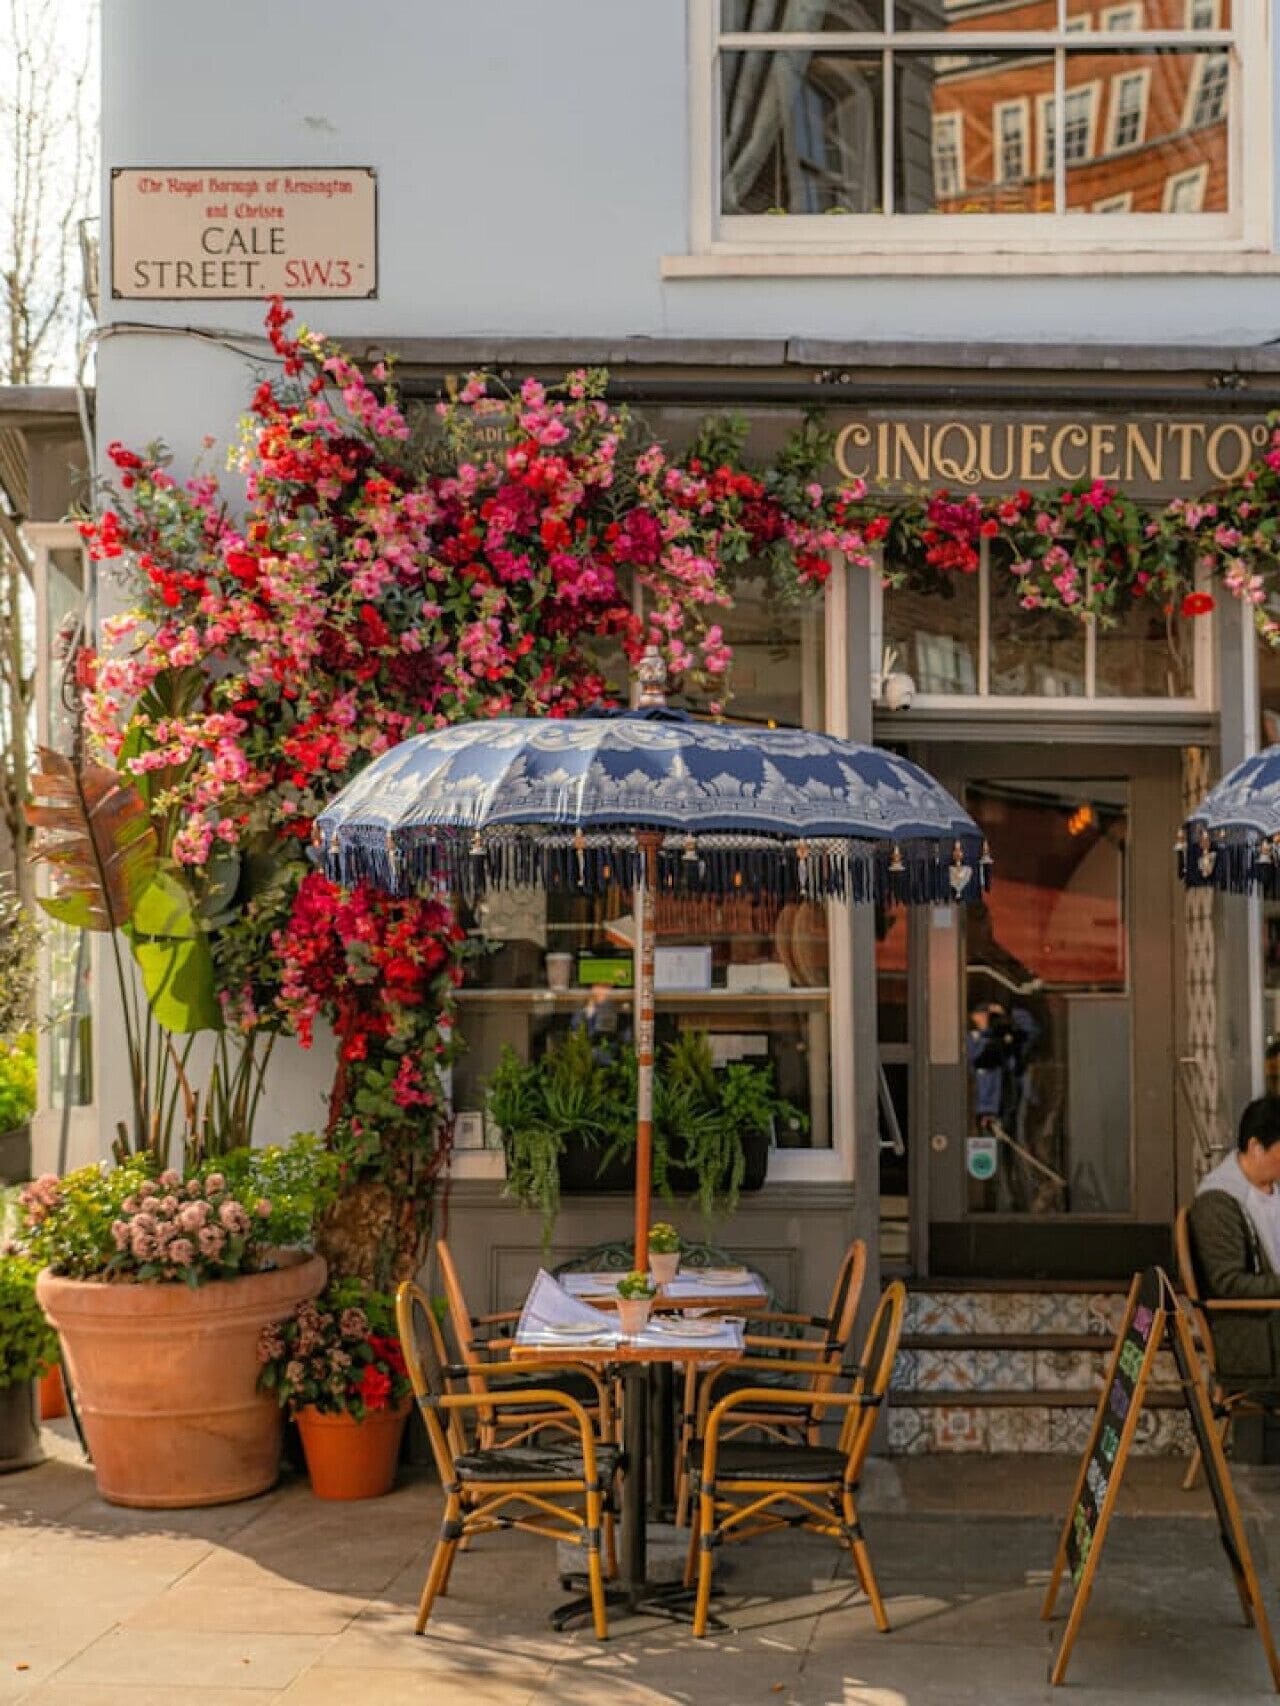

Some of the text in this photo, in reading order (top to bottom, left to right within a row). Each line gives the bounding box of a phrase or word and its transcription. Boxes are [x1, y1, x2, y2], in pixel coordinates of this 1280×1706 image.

[138, 177, 353, 199] The Royal Borough of Kensington
[206, 203, 285, 219] and Chelsea
[201, 226, 286, 255] CALE
